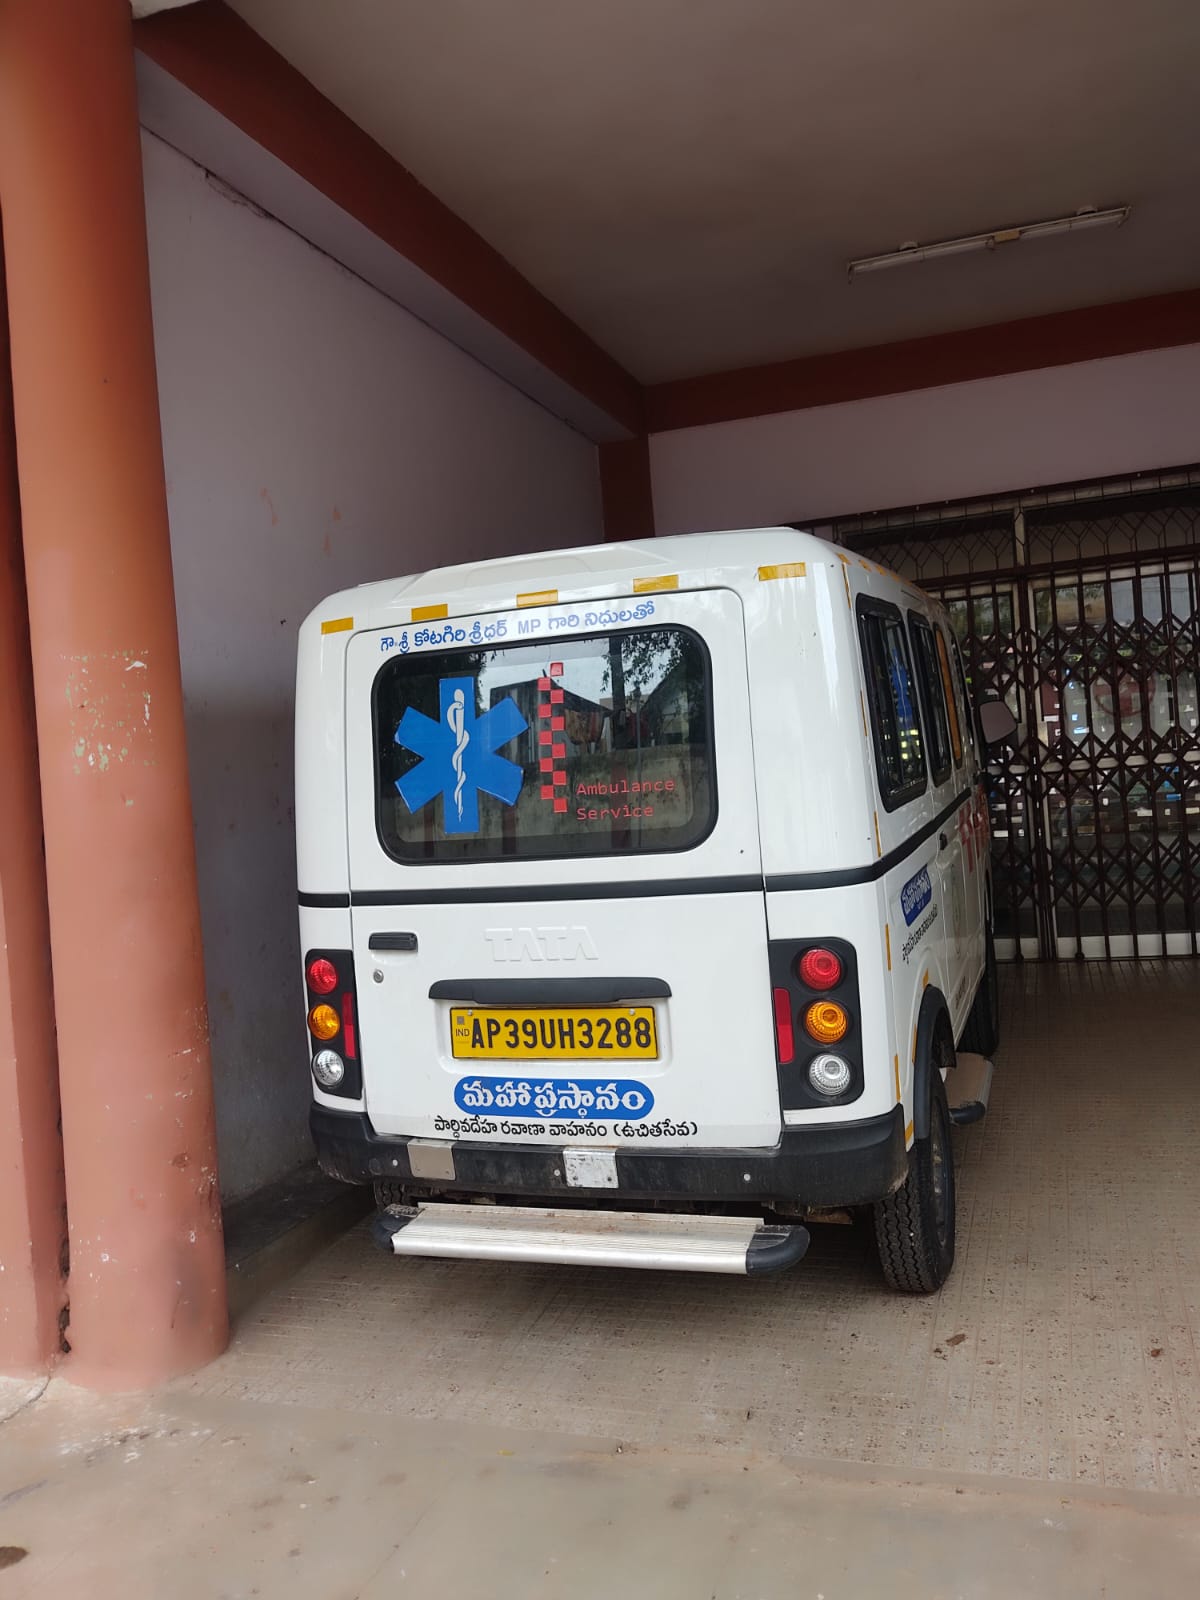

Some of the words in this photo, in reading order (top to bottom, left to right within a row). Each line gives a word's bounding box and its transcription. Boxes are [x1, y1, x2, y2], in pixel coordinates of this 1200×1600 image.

[414, 625, 466, 647] కోటగిరి
[518, 619, 541, 634] MP
[548, 614, 580, 630] గారి
[584, 600, 656, 628] నిధులతో
[576, 779, 676, 796] Ambulance
[576, 804, 654, 821] Service
[484, 926, 600, 963] TATA
[455, 1028, 470, 1037] IND
[471, 1017, 652, 1049] AP39UH3288
[500, 1120, 546, 1136] రవాణా
[549, 1120, 608, 1137] వాహనం
